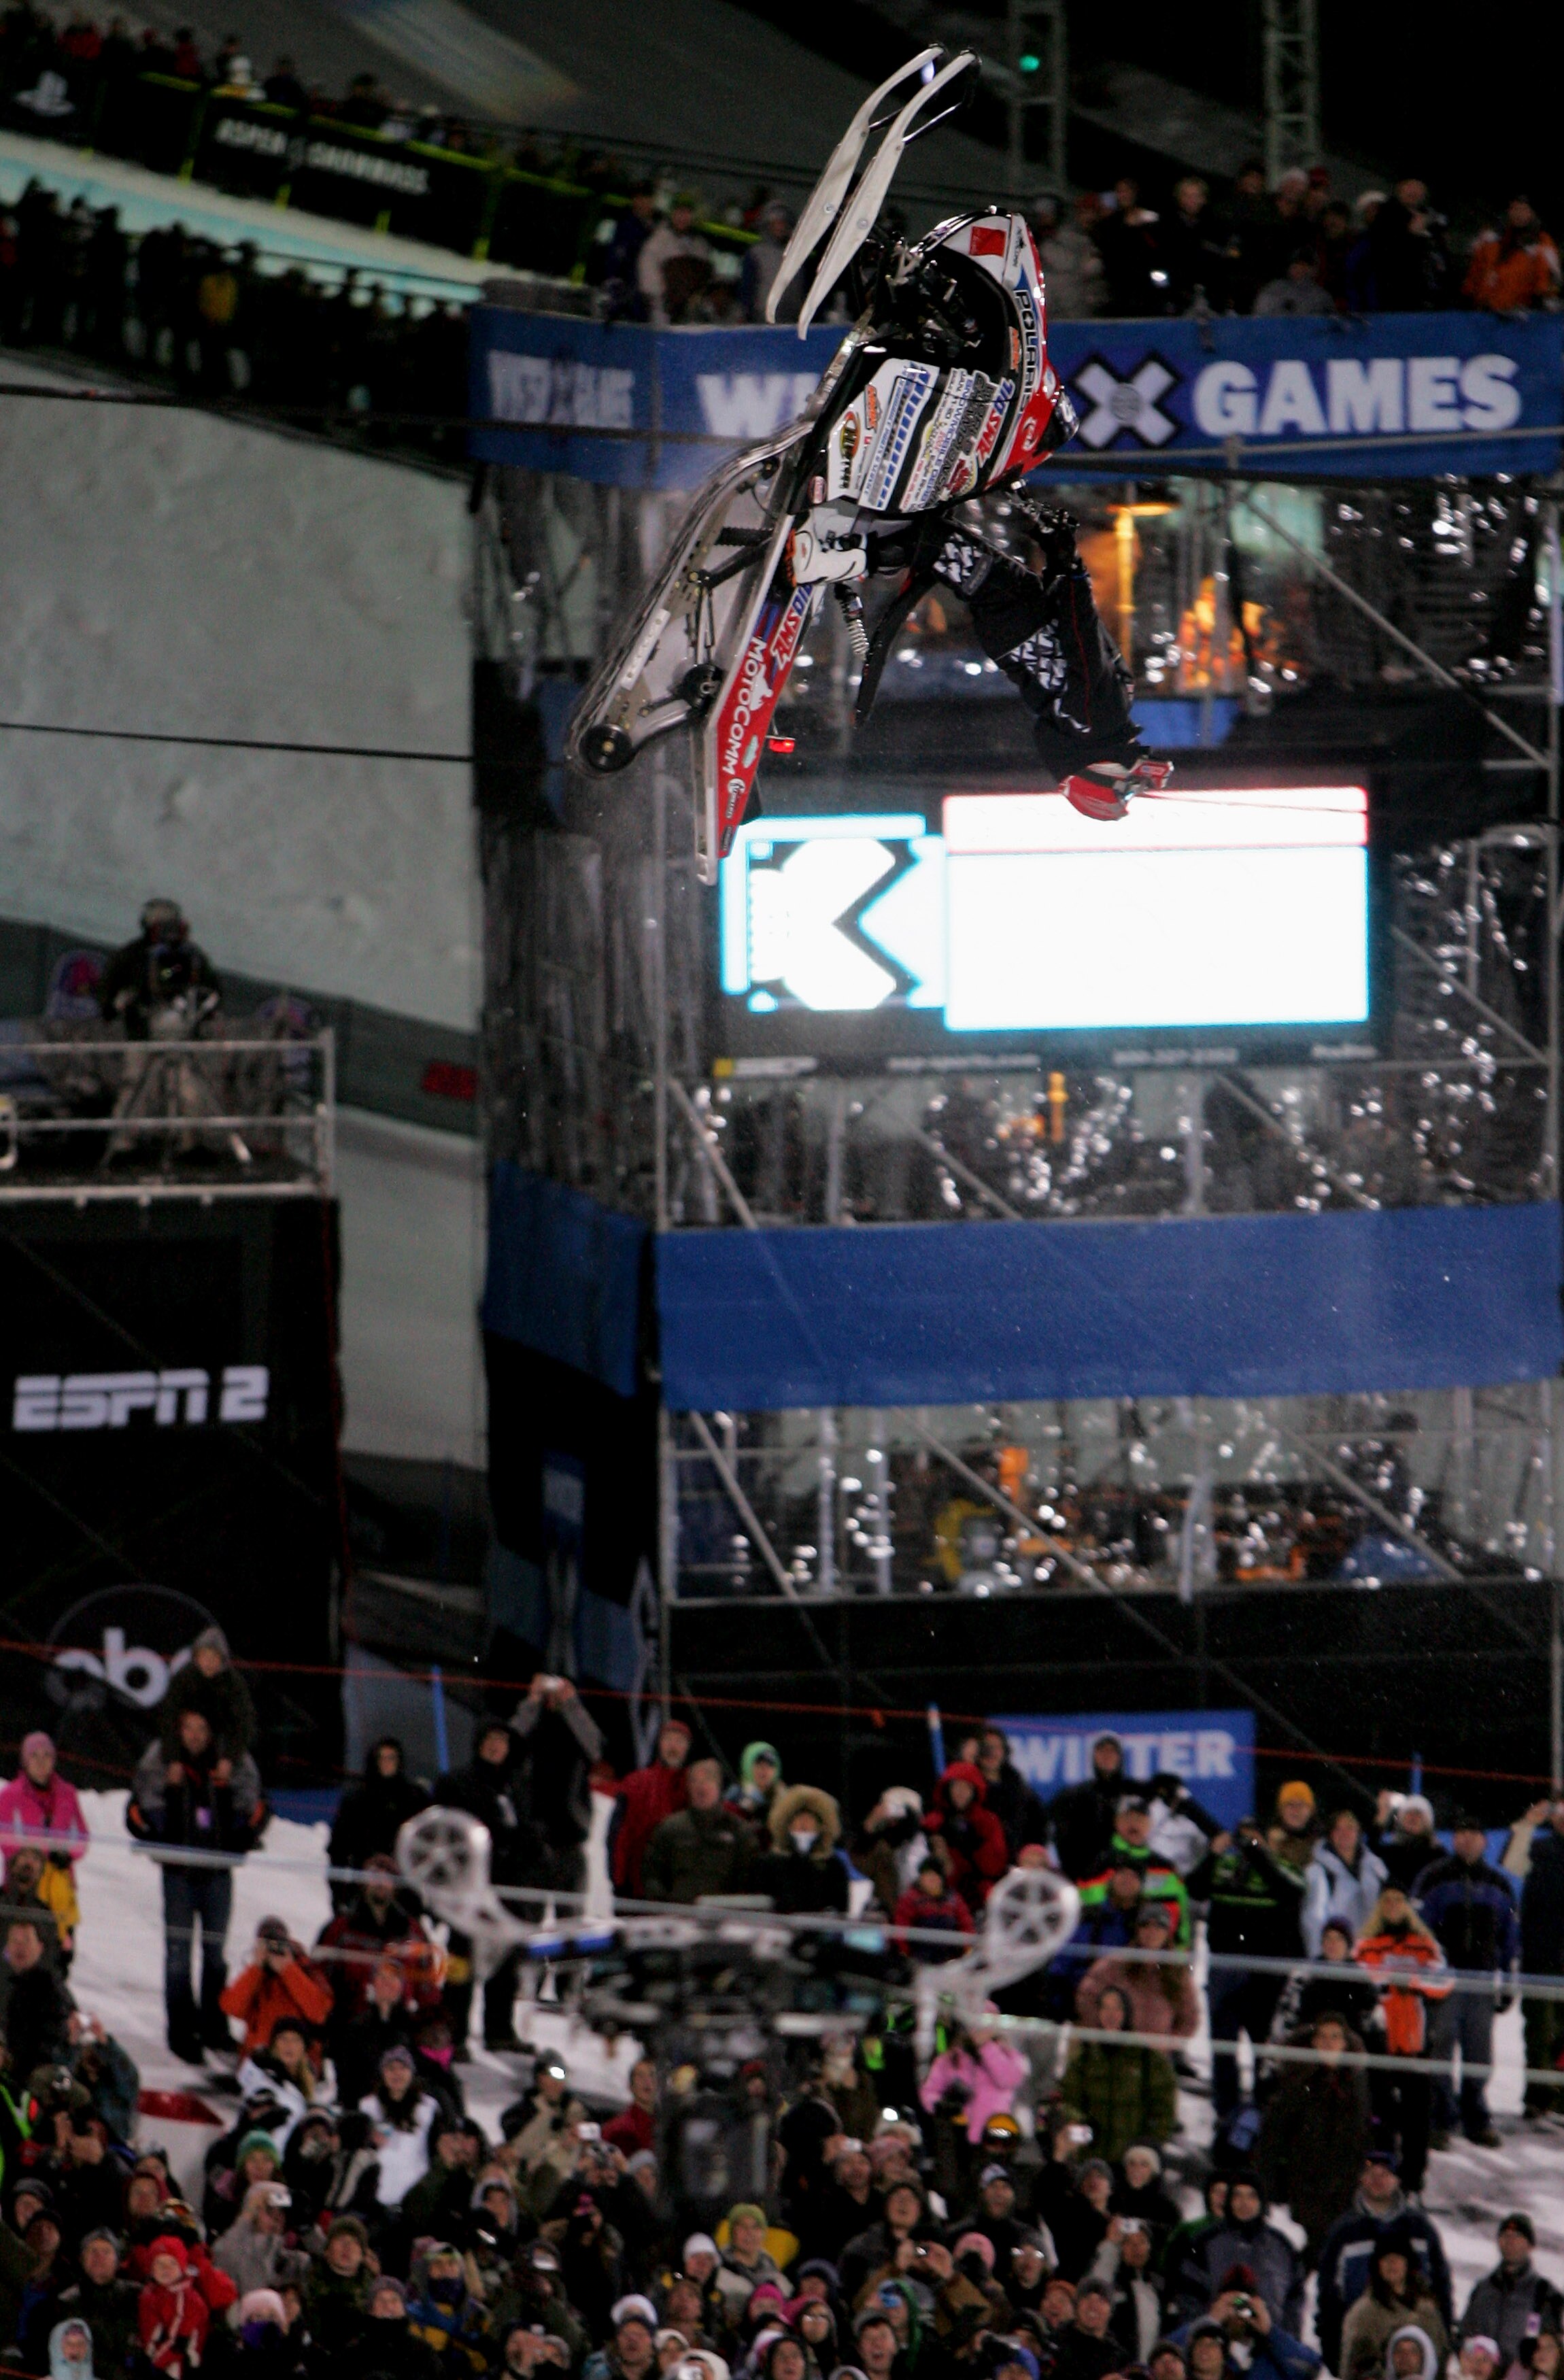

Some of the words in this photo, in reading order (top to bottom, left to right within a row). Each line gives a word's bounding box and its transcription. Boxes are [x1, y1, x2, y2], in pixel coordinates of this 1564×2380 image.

[1014, 289, 1039, 413] POLARIS
[974, 378, 1014, 462] AMSOIL
[1193, 354, 1522, 438] GAMES
[770, 583, 814, 666] AMSOIL
